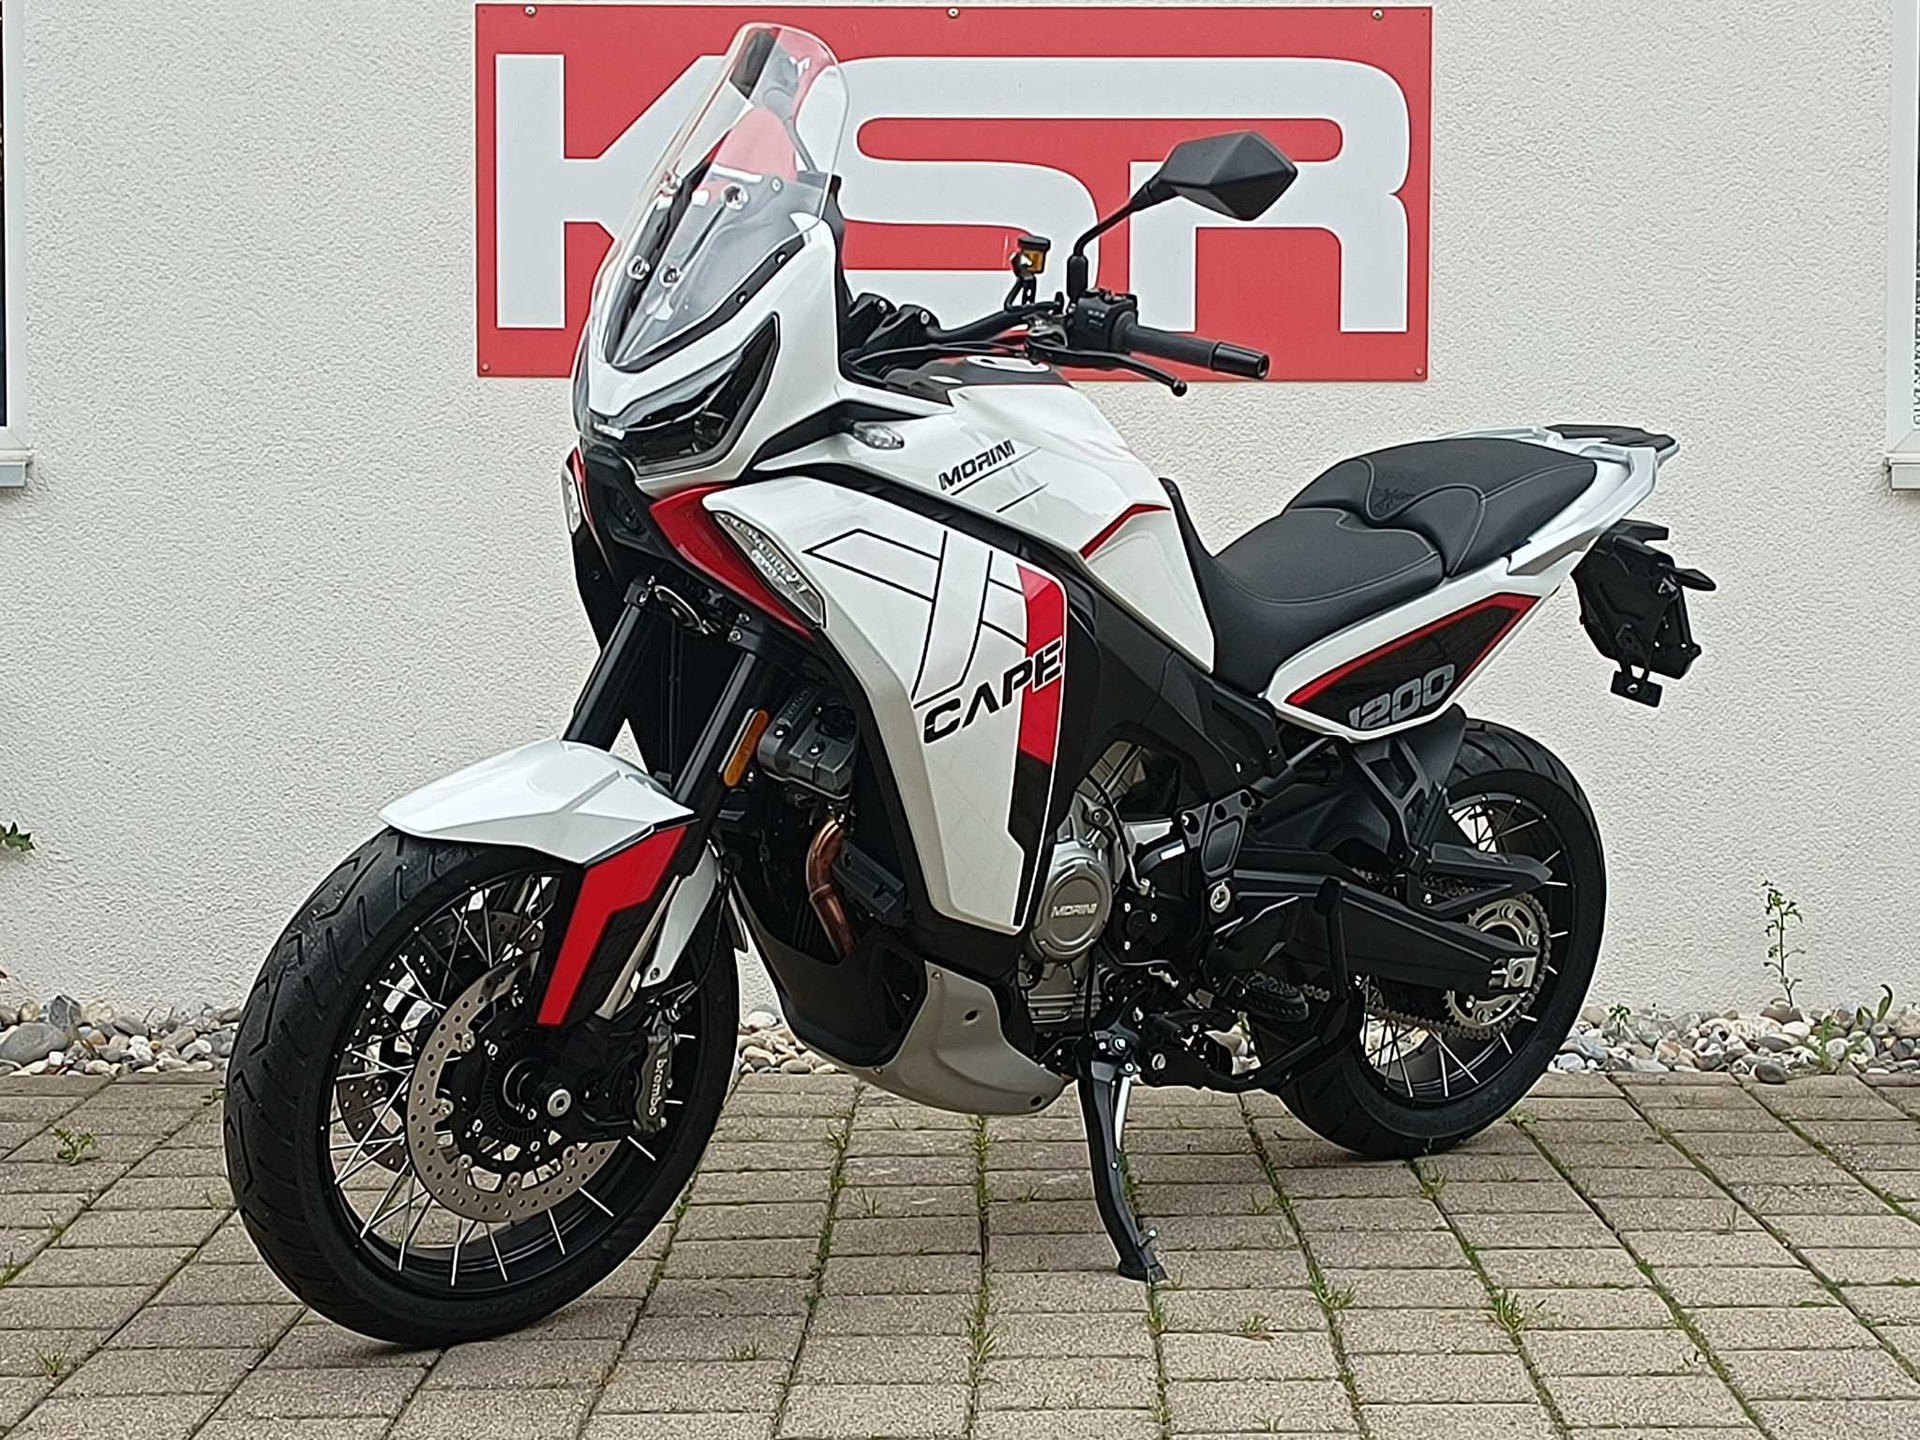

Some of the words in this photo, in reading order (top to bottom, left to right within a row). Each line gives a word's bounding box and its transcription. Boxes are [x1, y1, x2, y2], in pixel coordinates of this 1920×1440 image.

[495, 54, 1409, 333] KSR
[938, 440, 1016, 490] MORINI
[923, 639, 1063, 744] CAPE
[1349, 663, 1455, 729] 1200
[1050, 903, 1098, 918] MORINI
[649, 1059, 668, 1116] brembo
